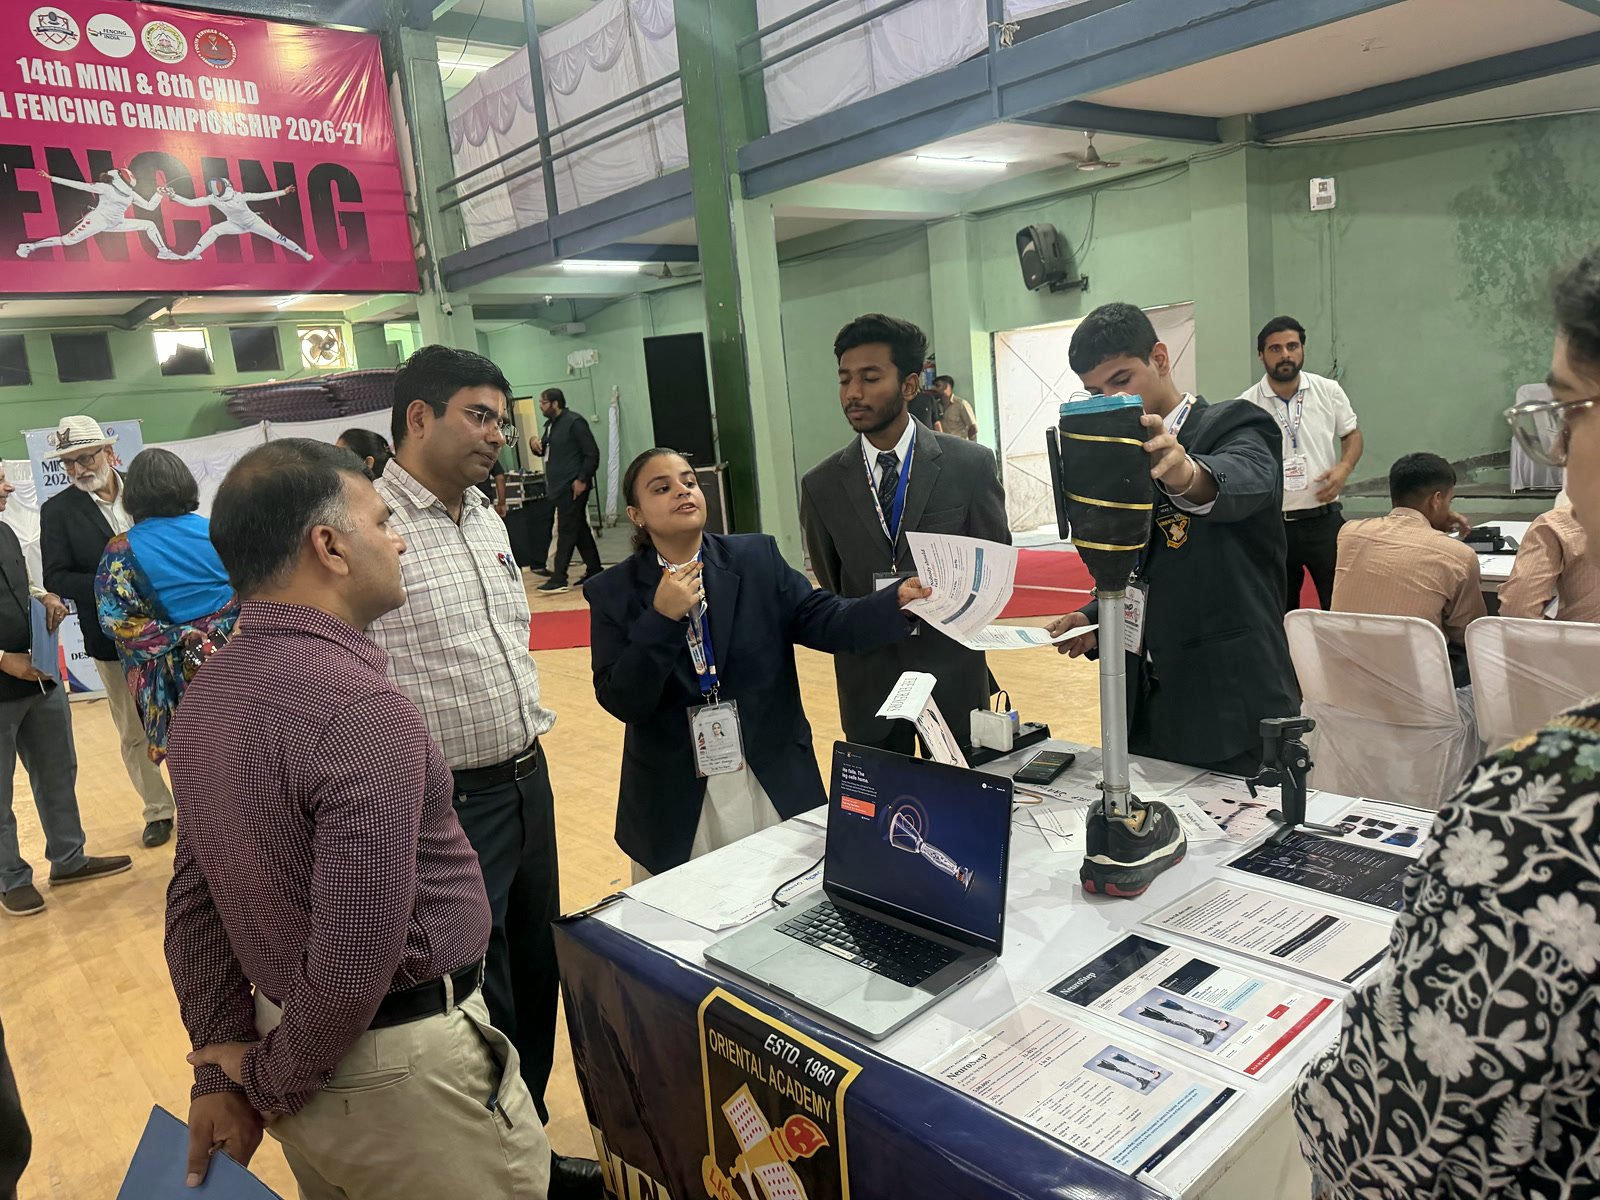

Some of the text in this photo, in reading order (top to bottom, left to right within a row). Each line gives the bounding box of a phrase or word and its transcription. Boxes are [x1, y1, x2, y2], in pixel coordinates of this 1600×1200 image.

[16, 57, 260, 105] 14th MINI & 8th CHILD
[14, 92, 118, 126] FENCING
[120, 102, 282, 139] CHAMPIONSHIP
[286, 117, 362, 145] 2026-27
[43, 473, 71, 486] 202
[71, 652, 90, 660] DES
[1060, 972, 1097, 996] NeuroStep
[708, 1028, 832, 1124] ORIENTAL ACADEMY
[764, 1034, 836, 1086] ESTD. 1960
[946, 1052, 987, 1080] NeuroStep
[708, 1168, 733, 1200] LIG
